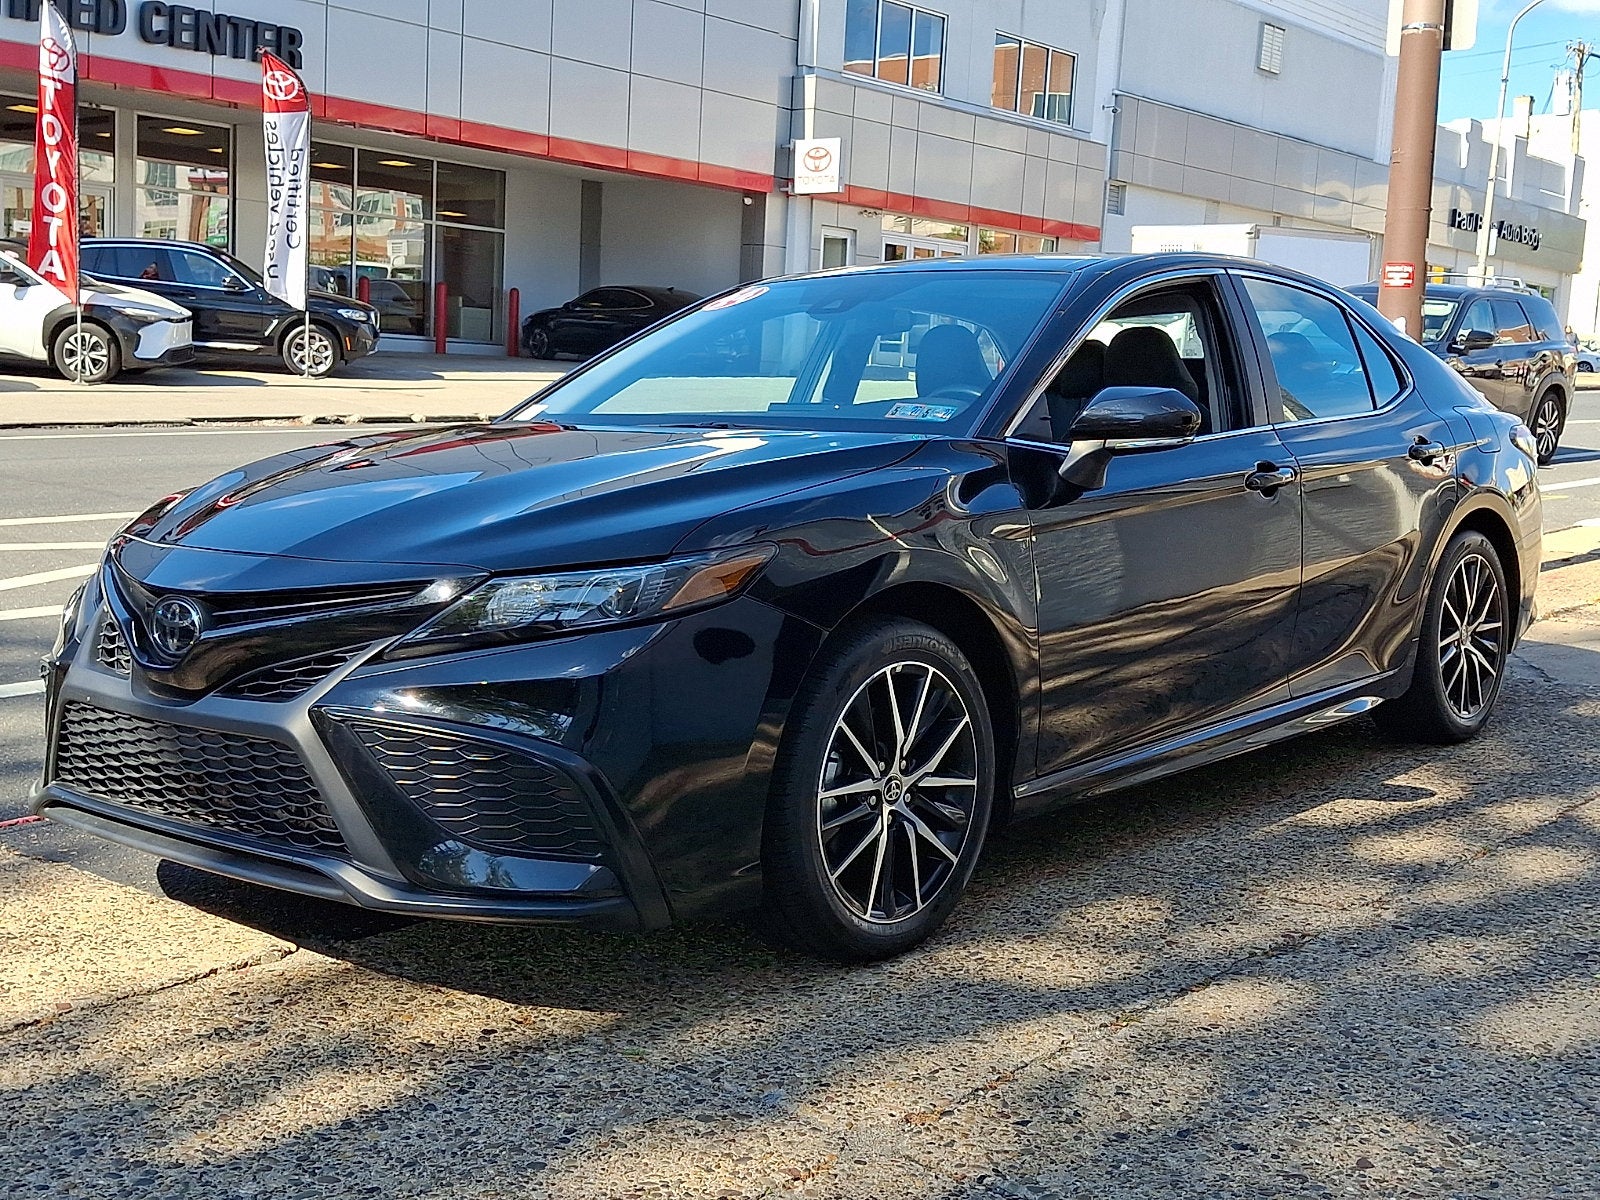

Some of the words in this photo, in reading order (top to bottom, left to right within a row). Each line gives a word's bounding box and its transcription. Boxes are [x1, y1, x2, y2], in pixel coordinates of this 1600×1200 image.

[140, 1, 303, 70] CENTER
[37, 76, 67, 282] TOYOTA
[1452, 208, 1478, 232] Paul
